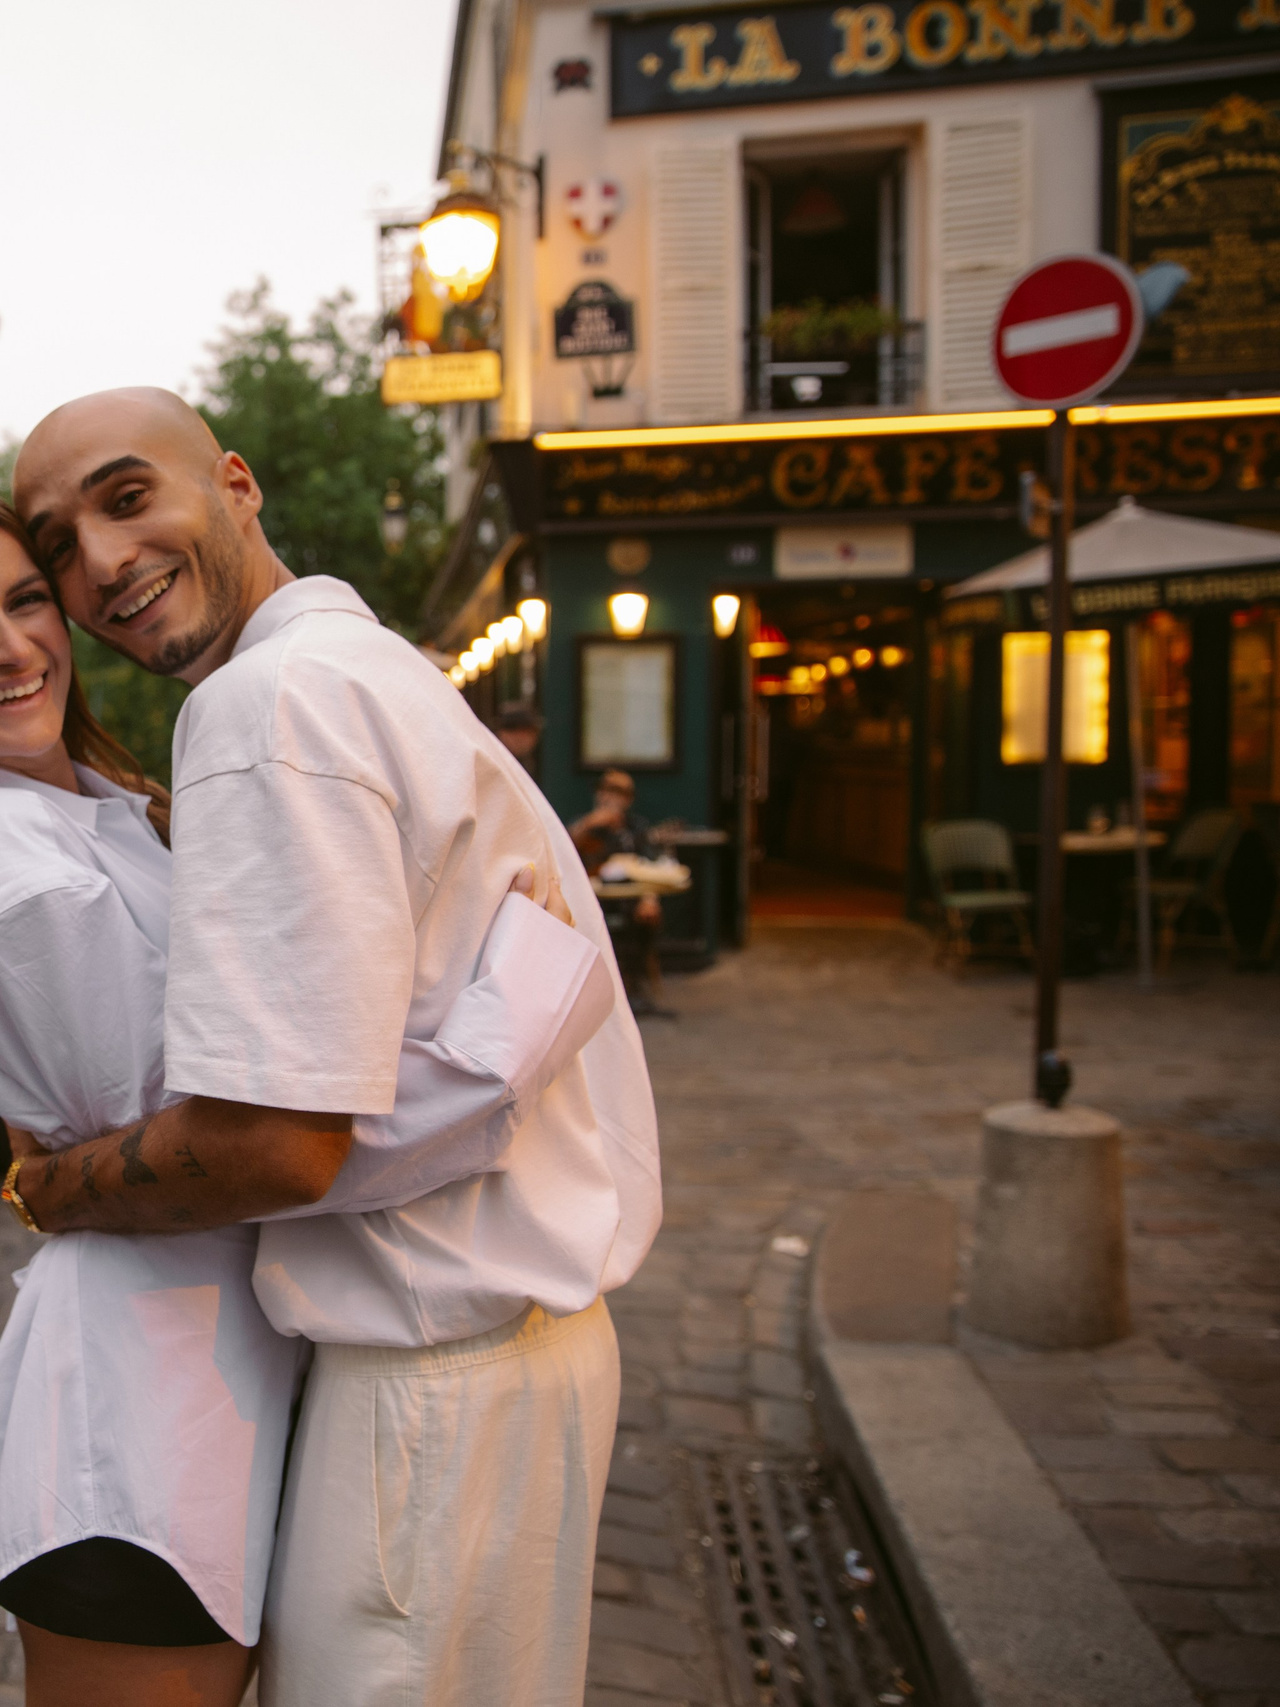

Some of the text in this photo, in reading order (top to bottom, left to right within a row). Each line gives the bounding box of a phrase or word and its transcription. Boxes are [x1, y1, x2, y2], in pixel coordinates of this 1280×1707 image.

[670, 0, 1196, 92] LA BONNE
[1074, 418, 1280, 494] REST
